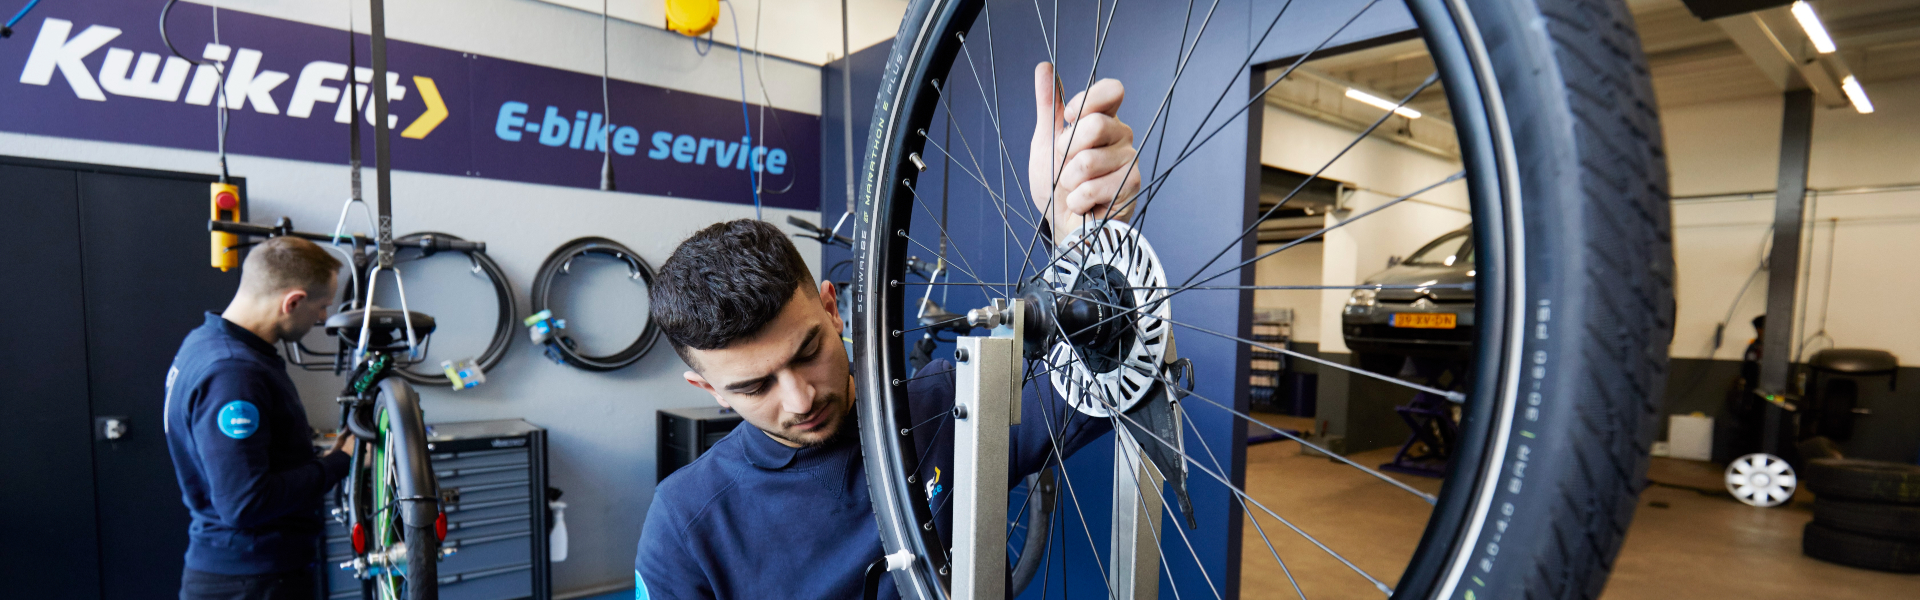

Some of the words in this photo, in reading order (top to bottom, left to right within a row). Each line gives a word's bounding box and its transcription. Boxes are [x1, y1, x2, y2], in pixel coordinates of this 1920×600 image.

[495, 101, 640, 156] E-bike
[648, 131, 788, 175] service
[857, 230, 868, 313] SCHWALBE
[865, 117, 885, 206] MARATHON
[887, 53, 903, 95] PLUS
[1508, 444, 1531, 494] BAR
